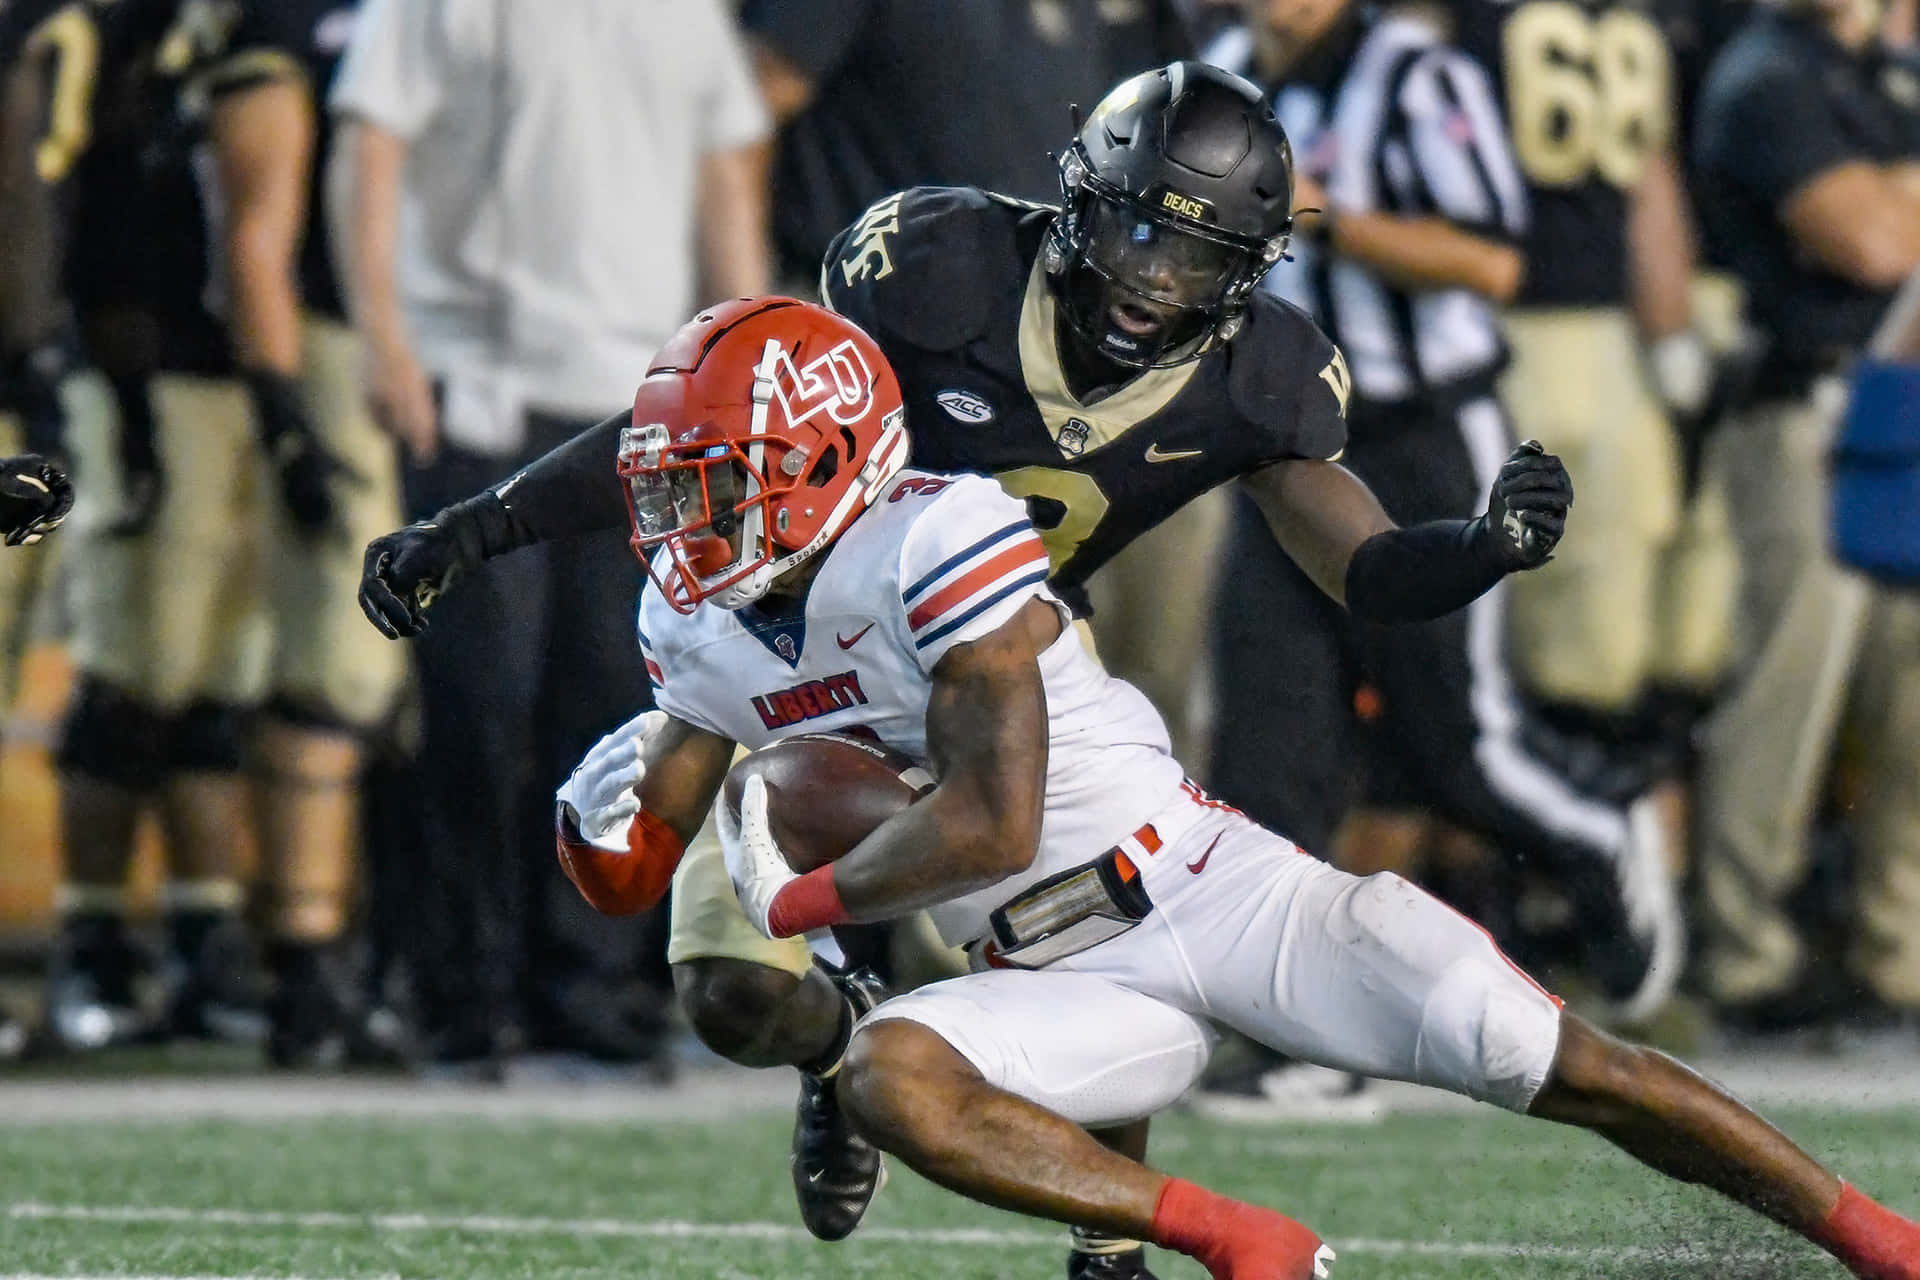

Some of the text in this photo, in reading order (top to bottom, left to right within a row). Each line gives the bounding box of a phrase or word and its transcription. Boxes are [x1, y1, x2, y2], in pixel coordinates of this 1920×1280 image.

[1163, 191, 1203, 218] DEACS
[752, 339, 873, 429] LU
[938, 397, 989, 419] ACC
[749, 669, 869, 731] LIBERTY
